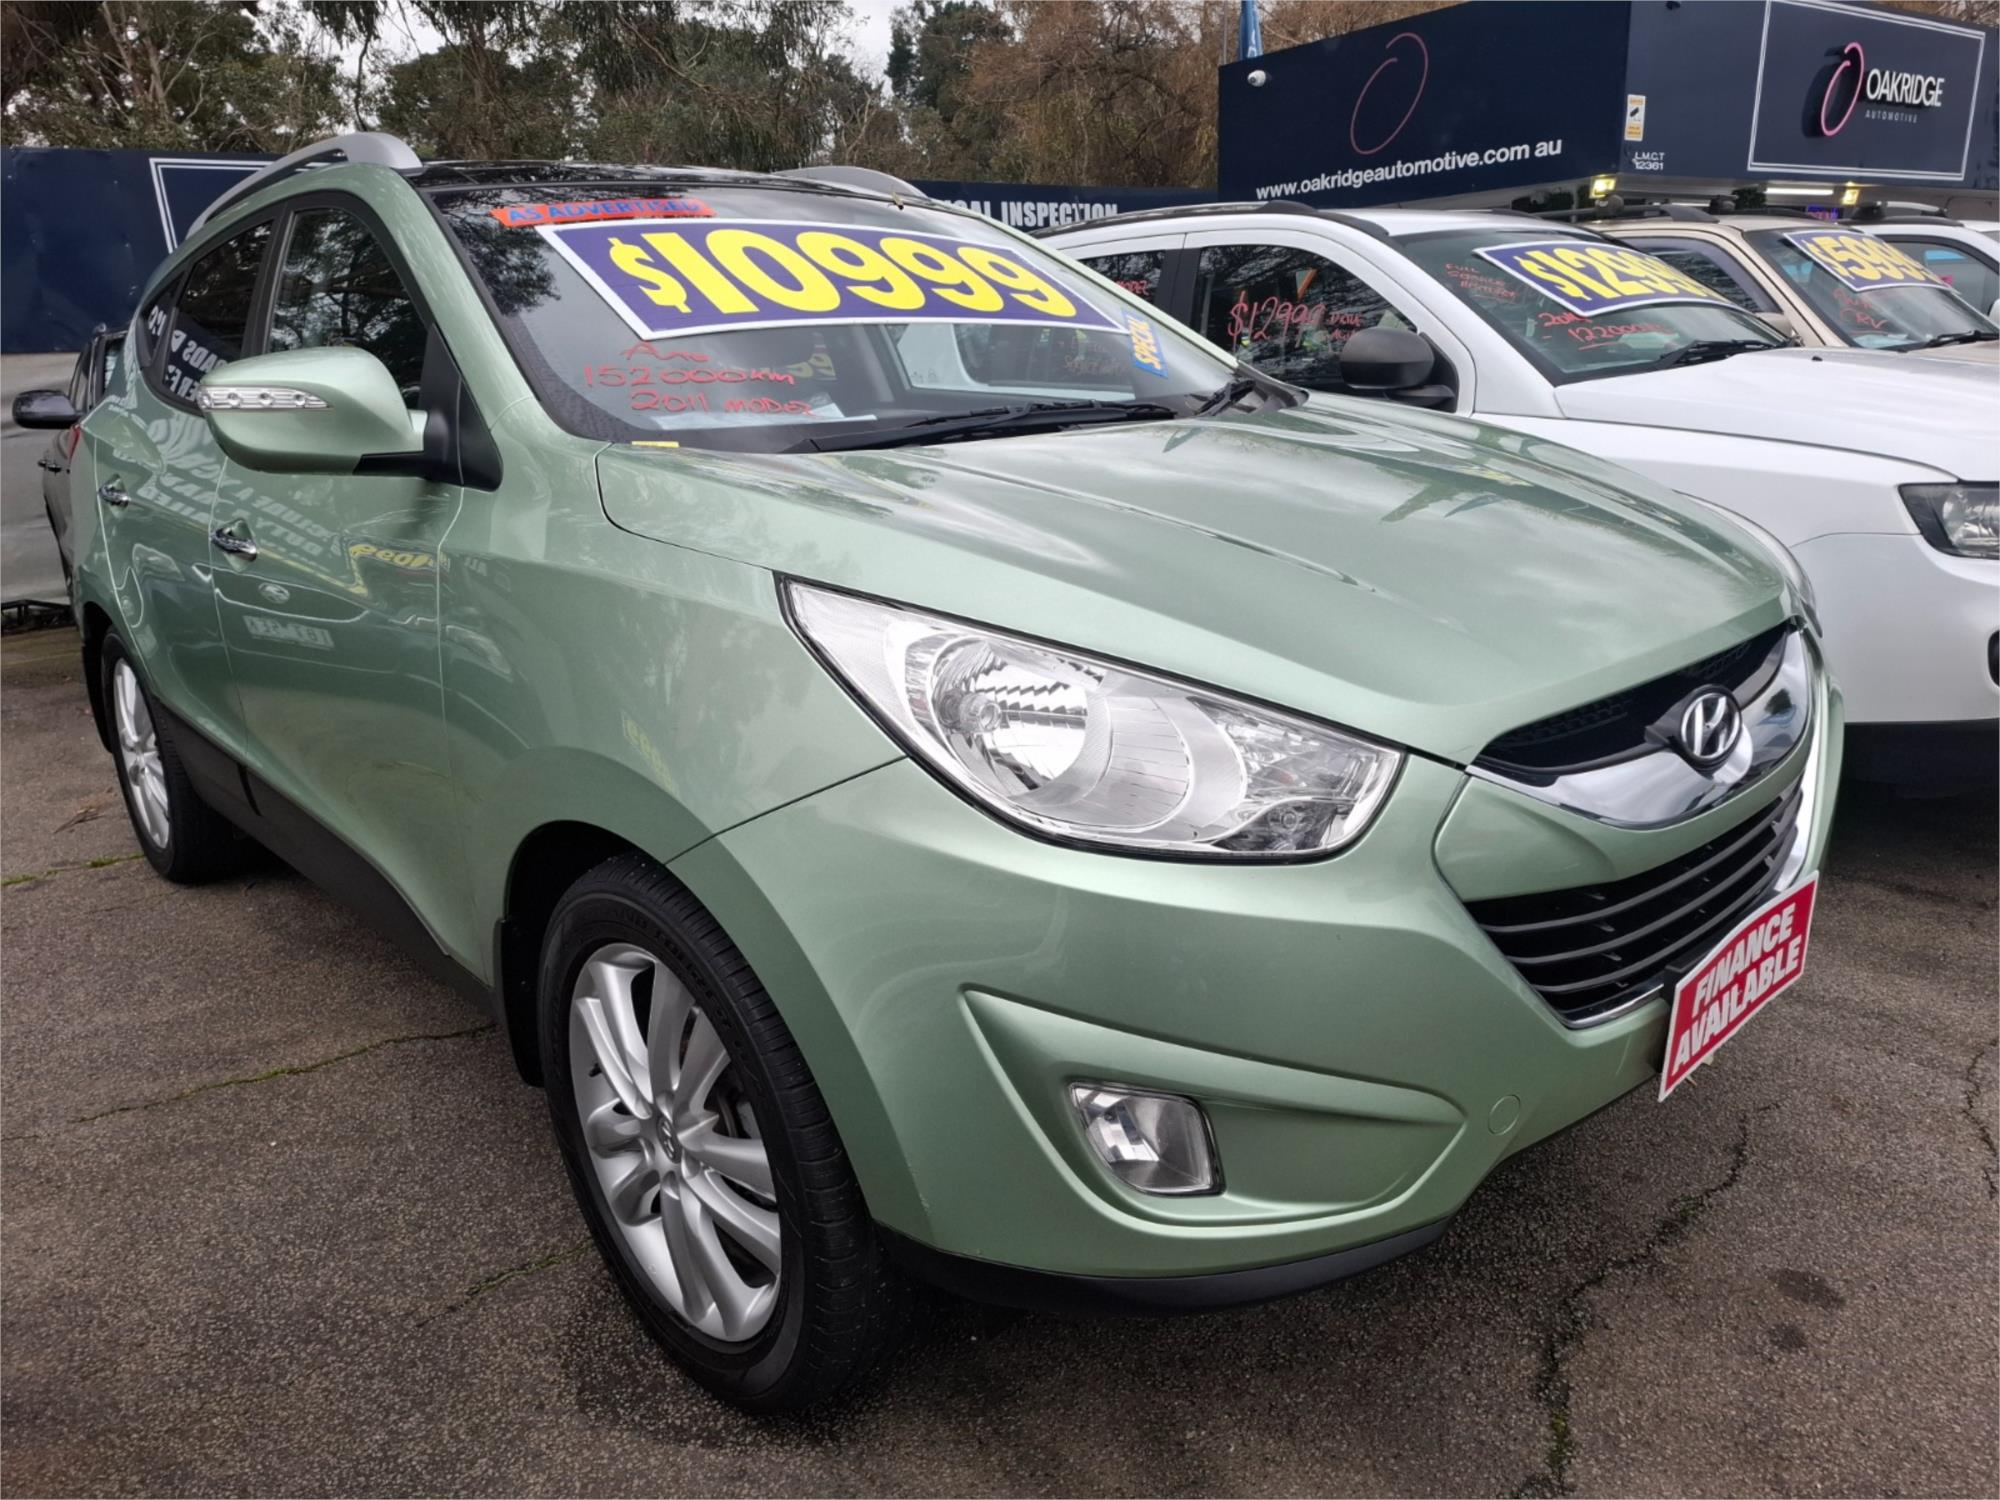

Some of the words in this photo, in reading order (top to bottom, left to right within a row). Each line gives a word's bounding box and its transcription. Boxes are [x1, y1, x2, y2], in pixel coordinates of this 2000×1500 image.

[1865, 110, 1918, 123] AUTOMOTIVE
[1866, 68, 1945, 106] OAKRIDGE
[1256, 142, 1530, 200] www.oakridgeautomotive.com
[1535, 138, 1562, 157] au
[508, 206, 543, 222] AS
[547, 200, 701, 217] ADVERTISED
[607, 229, 1077, 317] $10999
[1691, 902, 1797, 1019] FINANCE
[1671, 934, 1803, 1077] AVAILABLE
